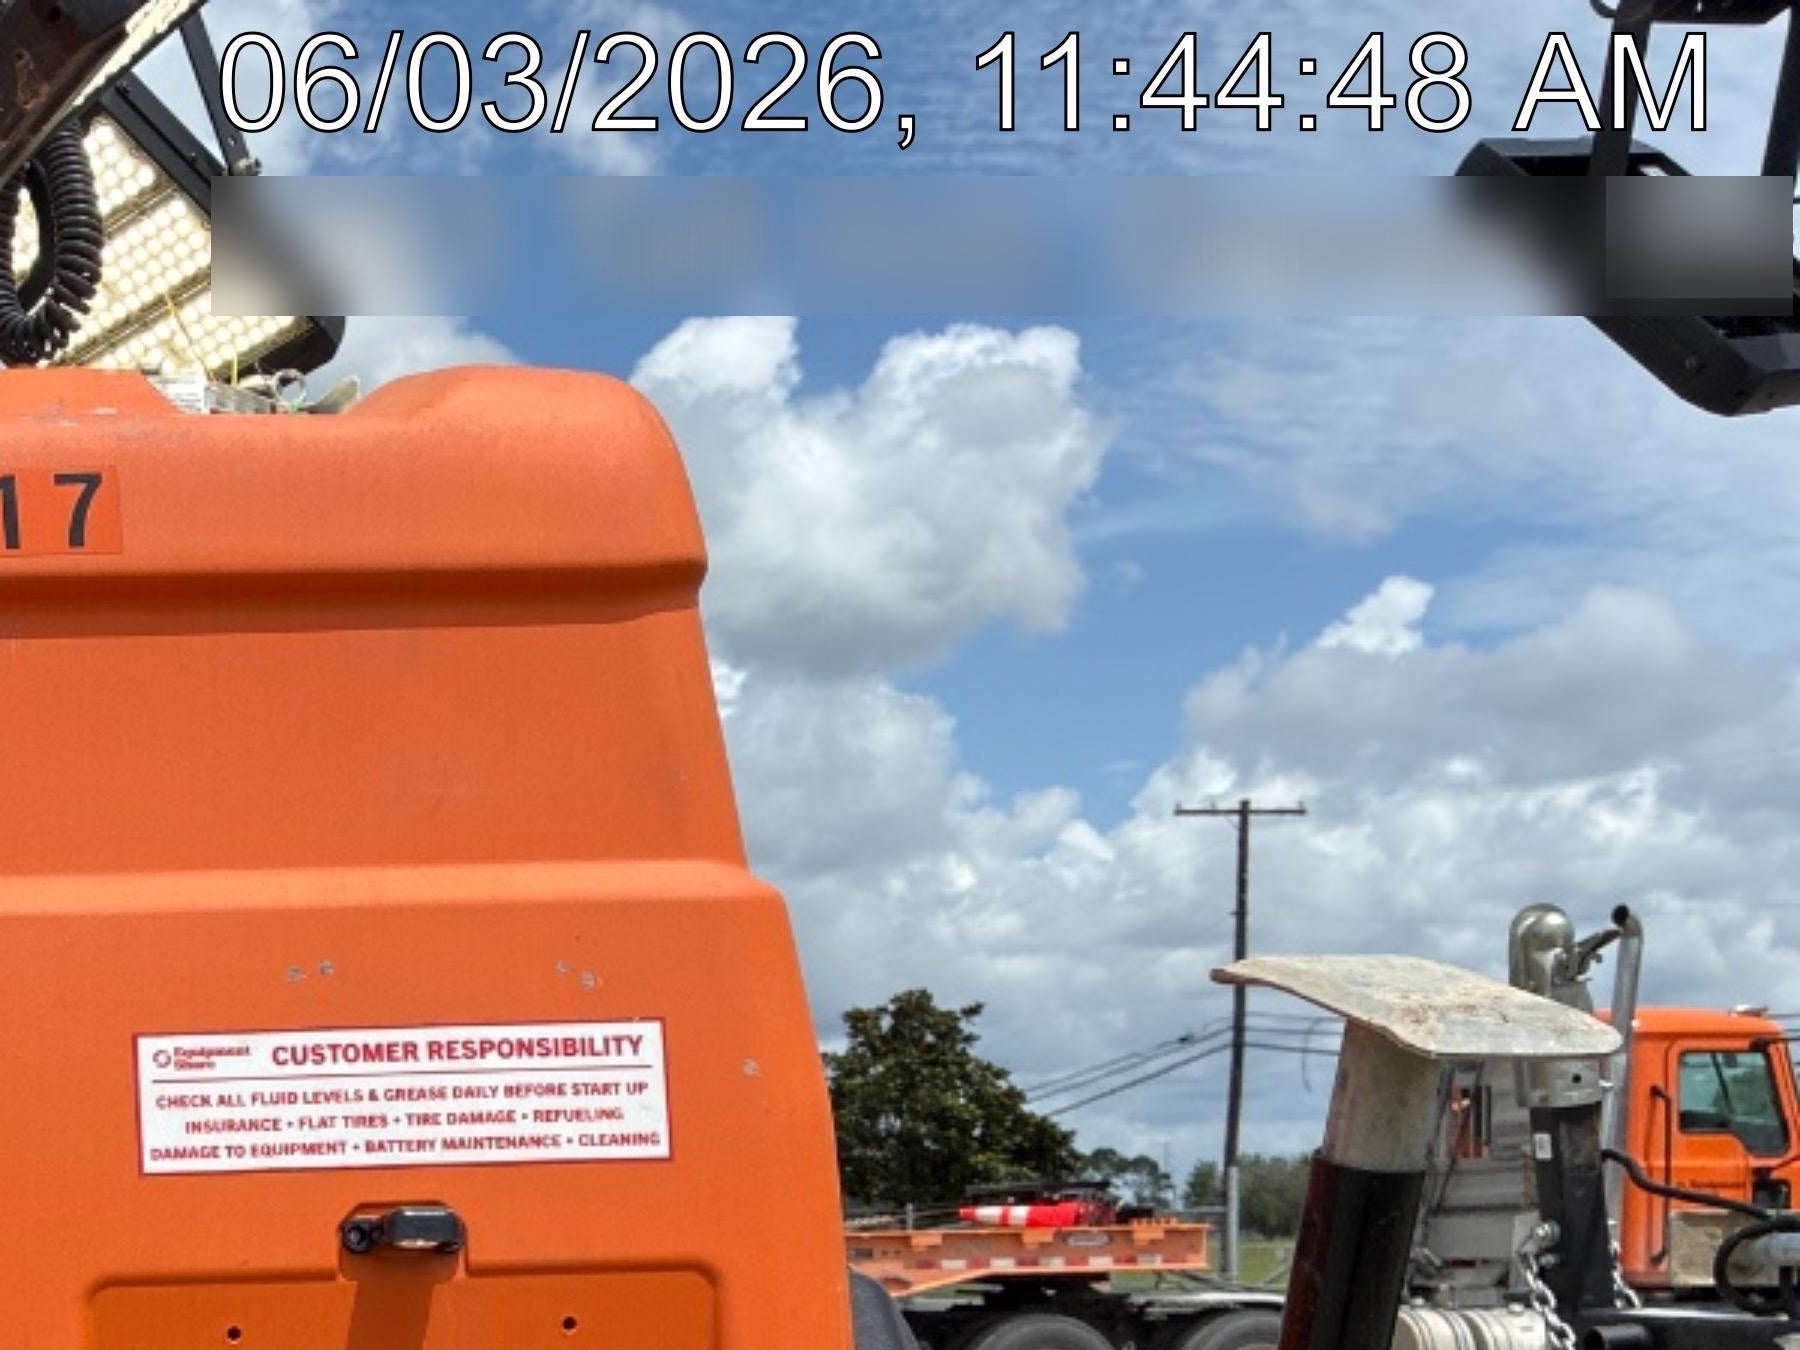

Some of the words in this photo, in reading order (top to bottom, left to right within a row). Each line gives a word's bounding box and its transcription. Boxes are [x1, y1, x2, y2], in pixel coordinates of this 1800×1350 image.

[173, 1045, 251, 1059] Equipment
[272, 1040, 420, 1066] CUSTOMER
[426, 1034, 644, 1061] RESPONSIBILITY
[156, 1093, 213, 1110] CHECK
[216, 1092, 246, 1108] ALL
[251, 1090, 298, 1107] FLUID
[303, 1088, 364, 1105] LEVELS
[368, 1088, 380, 1102] &
[383, 1085, 448, 1102] GREASE
[452, 1084, 499, 1100] DAILY
[503, 1082, 567, 1098] BEFORE
[571, 1081, 621, 1097] START
[626, 1081, 649, 1096] UP
[185, 1117, 282, 1135] INSURANCE
[299, 1115, 337, 1131] FLAT
[342, 1113, 388, 1129] TIRES
[405, 1112, 441, 1126] TIRE
[446, 1109, 517, 1126] DAMAGE
[532, 1106, 625, 1123] REFUELING
[150, 1144, 220, 1161] DAMAGE
[224, 1144, 246, 1159] TO
[251, 1140, 347, 1159] EQUIPMENT
[364, 1137, 436, 1155] BATTERY
[441, 1133, 561, 1151] MAINTENANCE
[578, 1130, 661, 1147] CLEANING
